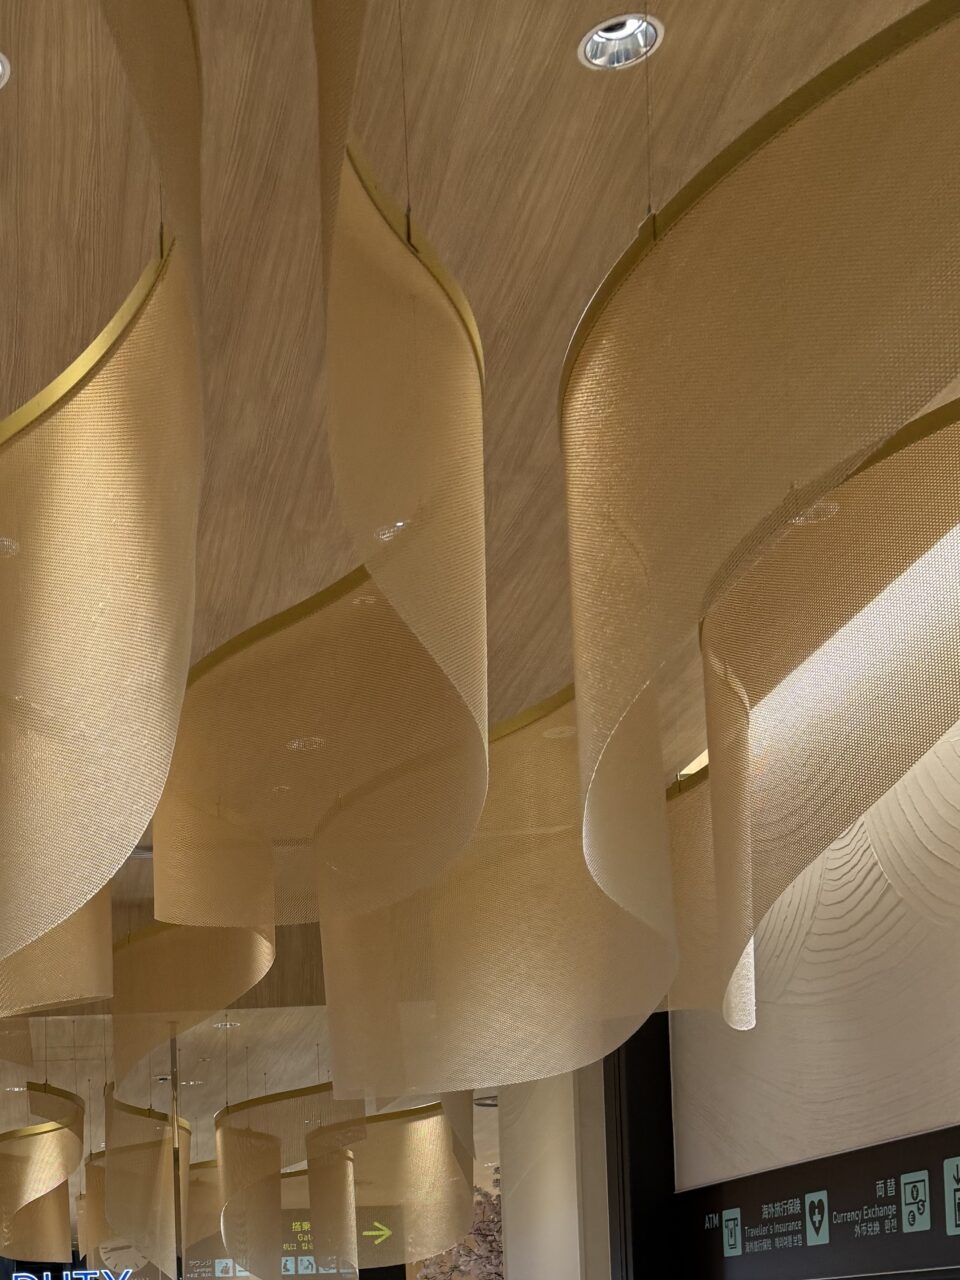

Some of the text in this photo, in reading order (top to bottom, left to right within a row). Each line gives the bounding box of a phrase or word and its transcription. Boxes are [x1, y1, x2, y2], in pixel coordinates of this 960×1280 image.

[876, 1178, 896, 1198] 両替
[704, 1213, 720, 1230] ATM
[832, 1203, 897, 1225] Currency Exchange
[744, 1219, 802, 1239] Traveller's Insurance
